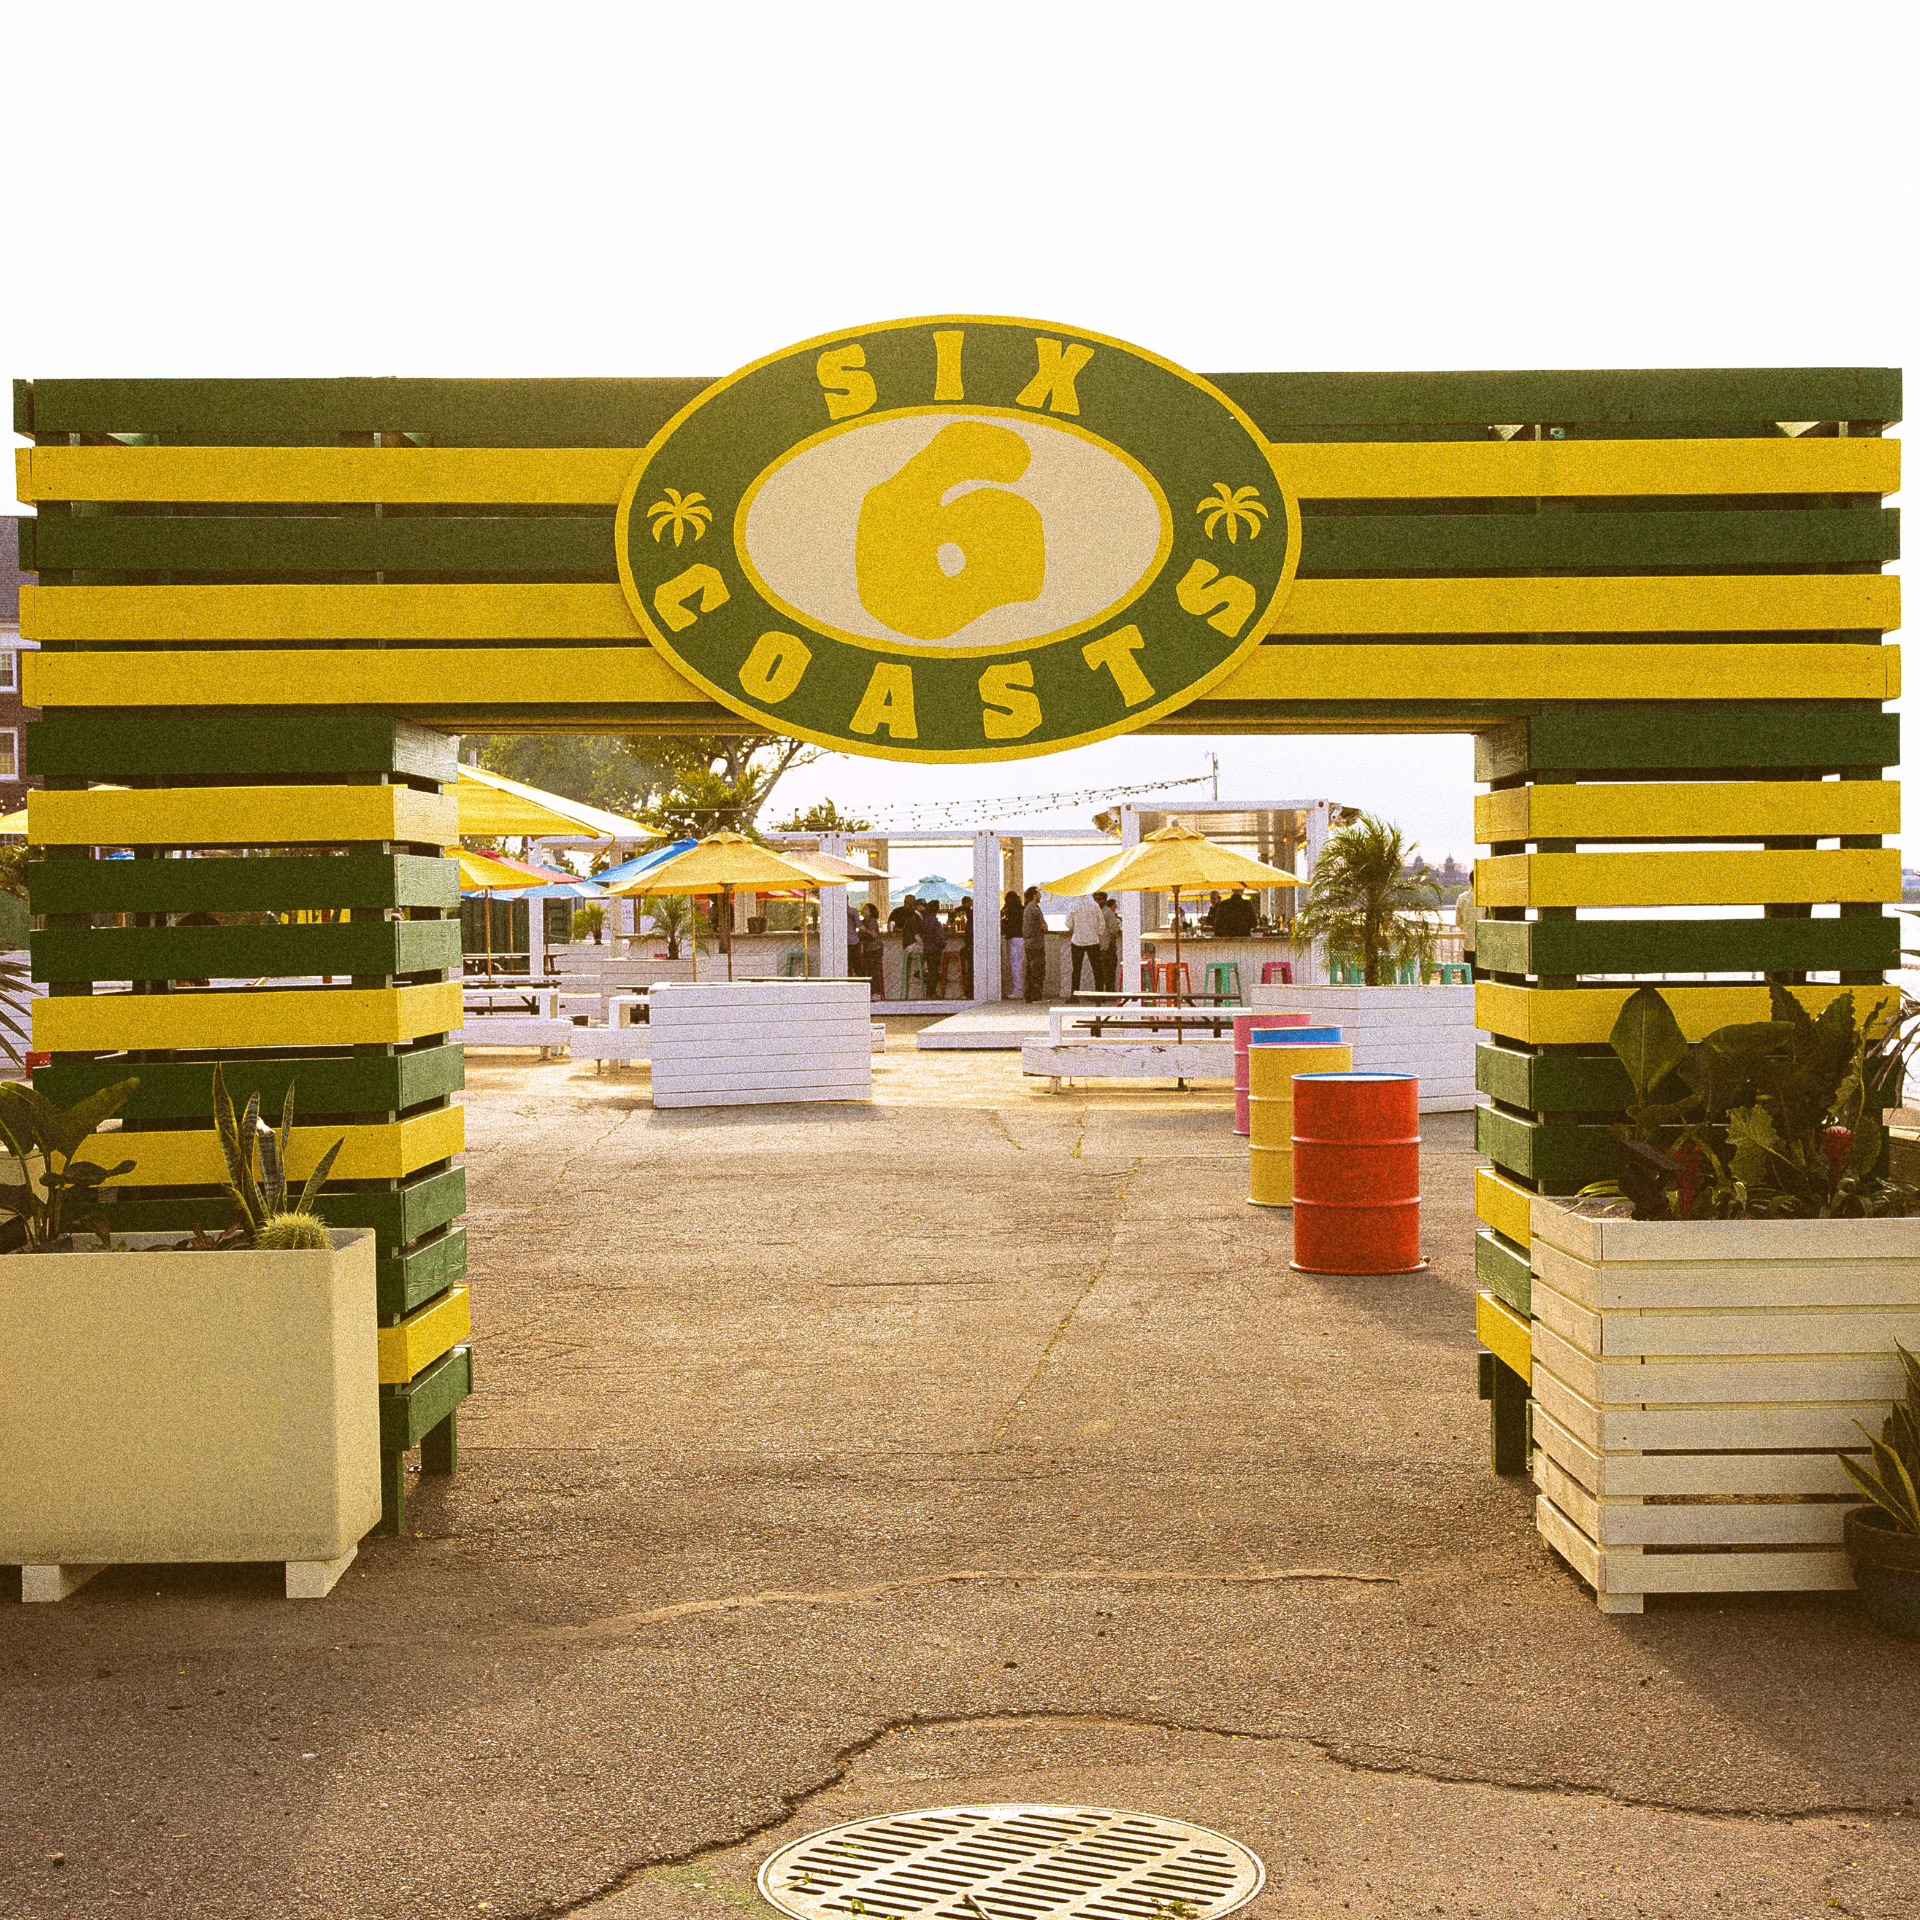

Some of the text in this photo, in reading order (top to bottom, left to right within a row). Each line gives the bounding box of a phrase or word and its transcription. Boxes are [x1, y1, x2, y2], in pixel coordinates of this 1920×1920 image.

[815, 329, 1095, 420] SIX
[855, 420, 1046, 640] 6
[653, 557, 1257, 740] COASTS
